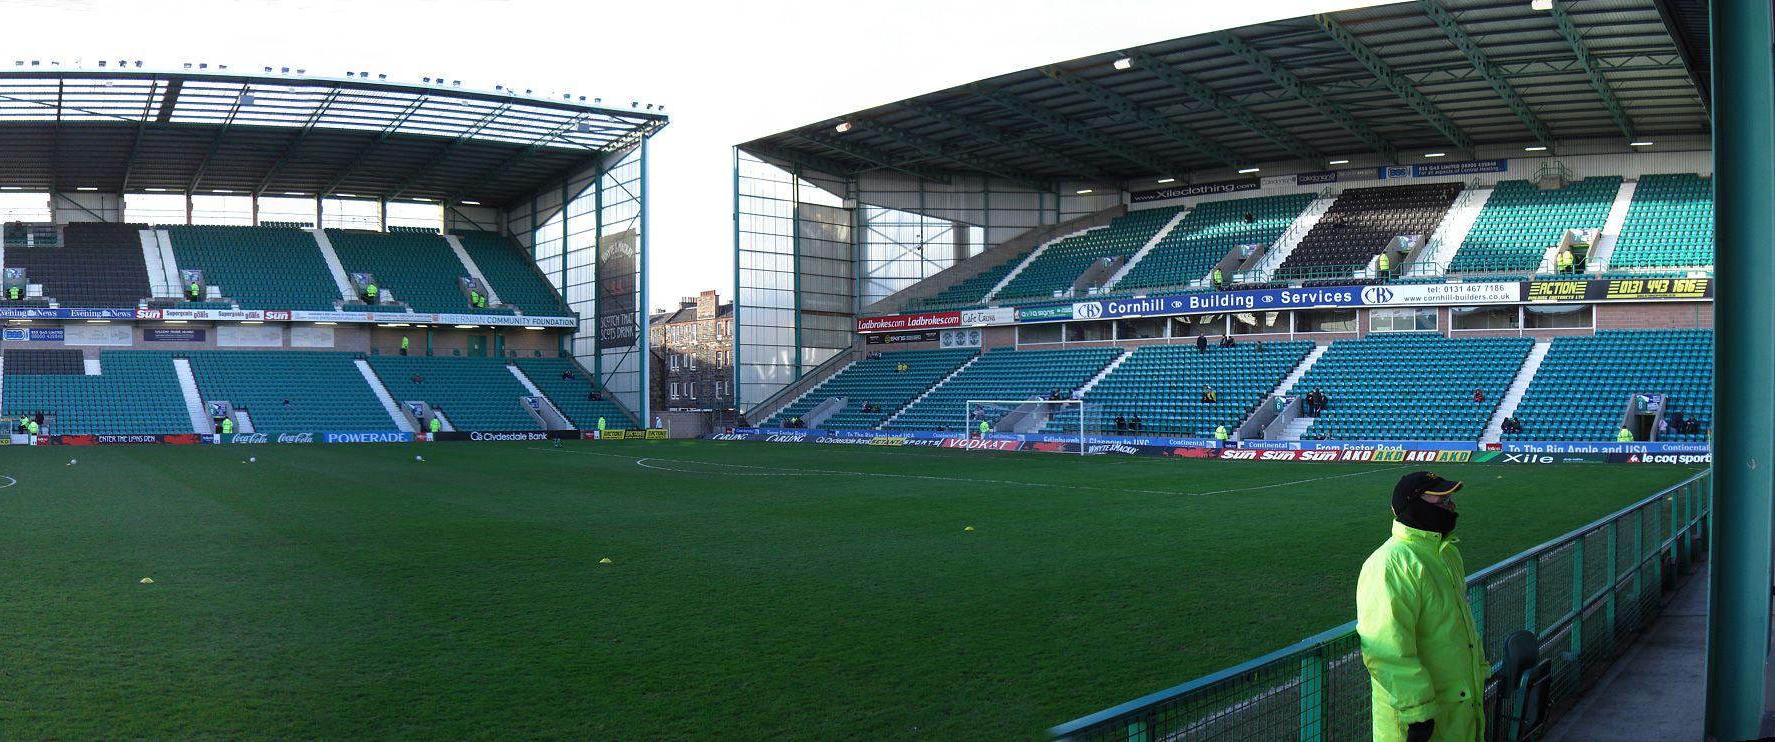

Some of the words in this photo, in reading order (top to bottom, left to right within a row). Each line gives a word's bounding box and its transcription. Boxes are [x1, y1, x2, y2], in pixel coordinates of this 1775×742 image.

[1444, 285, 1463, 293] 0131
[1467, 285, 1480, 293] 467
[1485, 284, 1504, 292] 7186
[1539, 281, 1577, 295] ACTION
[1619, 280, 1644, 294] 0131
[1647, 280, 1670, 293] 443
[1672, 279, 1697, 293] 1616
[1108, 298, 1164, 314] Cornhill
[1189, 293, 1254, 309] Building
[1281, 290, 1352, 304] Services
[36, 309, 57, 317] News
[71, 309, 102, 318] Evening
[111, 309, 131, 317] News
[136, 310, 160, 319] Sun
[264, 311, 288, 320] Sun
[962, 313, 977, 324] Cafe
[441, 315, 486, 324] HIBERNIAN
[487, 316, 531, 325] COMMUNITY
[532, 316, 574, 326] FOUNDATION
[601, 314, 620, 329] SCOTCH
[621, 312, 634, 325] THAT
[857, 318, 905, 330] Ladbrokes.com
[907, 315, 958, 327] Ladbrokes.com
[601, 327, 616, 341] SCOTS
[617, 325, 634, 338] DRINK
[99, 435, 116, 443] ENTER
[117, 435, 128, 443] THE
[144, 435, 156, 443] DEN
[328, 432, 409, 443] POWERADE
[484, 432, 527, 442] Clydesdale
[529, 432, 547, 441] Bank
[949, 439, 1012, 450] VODKAT
[1169, 439, 1205, 447] Continental
[1248, 440, 1288, 448] Continental
[1524, 444, 1543, 453] The
[1662, 443, 1710, 452] Continental
[1220, 449, 1257, 460] Sun
[1260, 449, 1297, 461] Sun
[1299, 450, 1338, 461] Sun
[1342, 450, 1371, 461] AKD
[1374, 451, 1404, 462] AKD
[1406, 451, 1437, 462] AKD
[1439, 451, 1468, 462] AKD
[1502, 453, 1554, 464] Xile
[1642, 453, 1653, 463] le
[1654, 454, 1678, 465] coq
